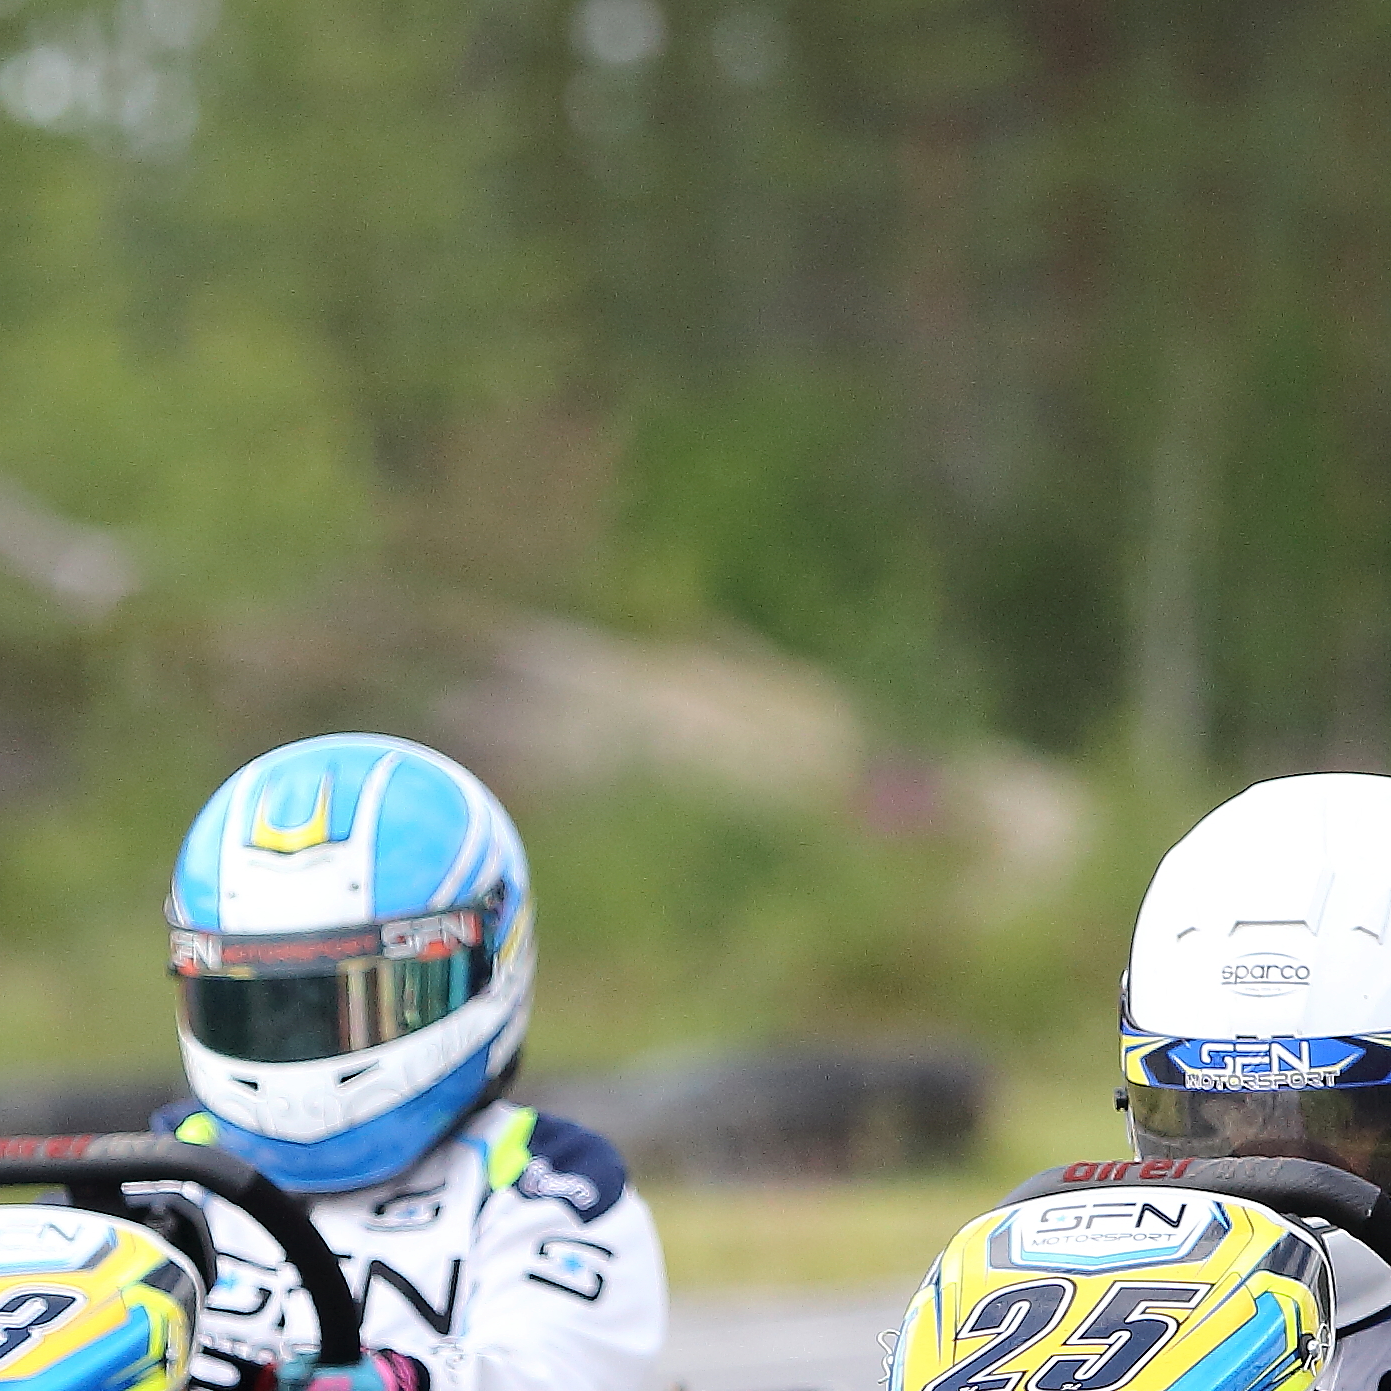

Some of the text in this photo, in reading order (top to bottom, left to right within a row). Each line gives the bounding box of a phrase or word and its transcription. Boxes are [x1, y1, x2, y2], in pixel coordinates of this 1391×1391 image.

[1221, 964, 1311, 985] sparco
[1200, 1040, 1310, 1076] SFN
[1036, 1202, 1187, 1234] SFN
[1031, 1232, 1180, 1247] MOTORSPORT
